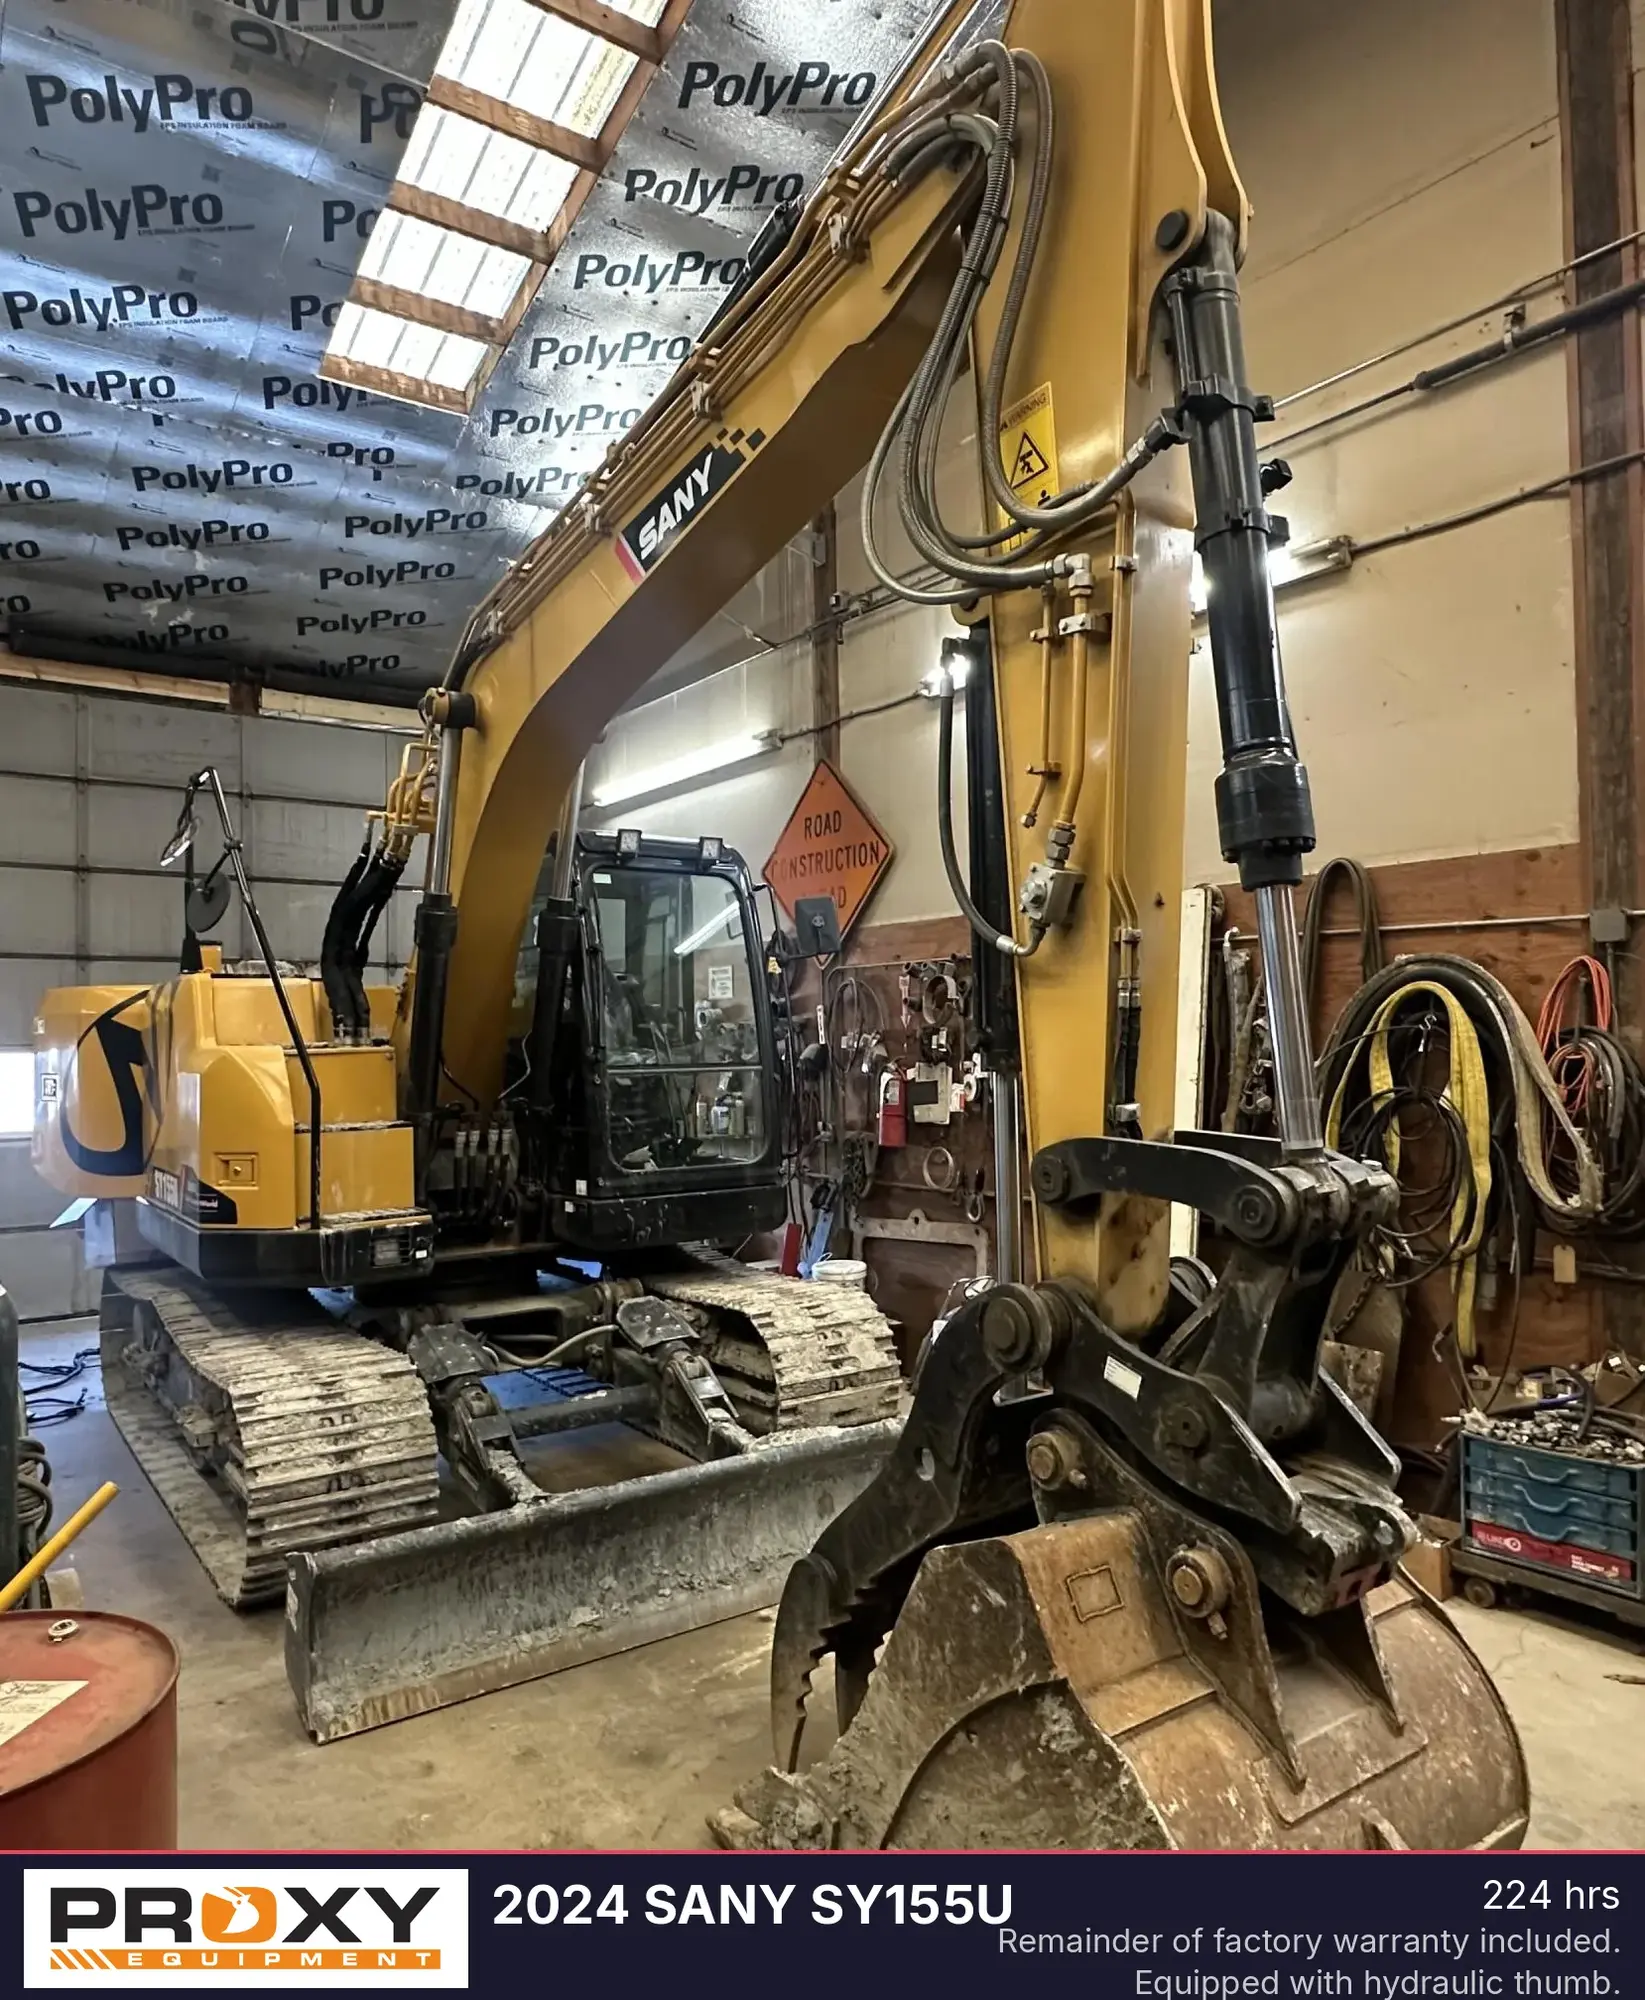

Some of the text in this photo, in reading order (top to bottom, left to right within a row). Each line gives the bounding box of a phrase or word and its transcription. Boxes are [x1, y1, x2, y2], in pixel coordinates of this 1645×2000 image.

[26, 74, 254, 133] PolyPro
[677, 61, 877, 116] PolyPro
[625, 165, 804, 216] PolyPro
[13, 184, 223, 240] PolyPro
[573, 251, 747, 294] PolyPro
[3, 285, 198, 332] PolyPro
[529, 331, 692, 371] PolyPro
[490, 404, 642, 438] PolyPro
[131, 460, 293, 493] PolyPro
[345, 509, 488, 538] PolyPro
[638, 451, 713, 560] SANY
[116, 520, 269, 551] PolyPro
[103, 574, 249, 602] PolyPro
[319, 561, 456, 590] PolyPro
[297, 609, 427, 636] PolyPro
[804, 810, 842, 840] ROAD
